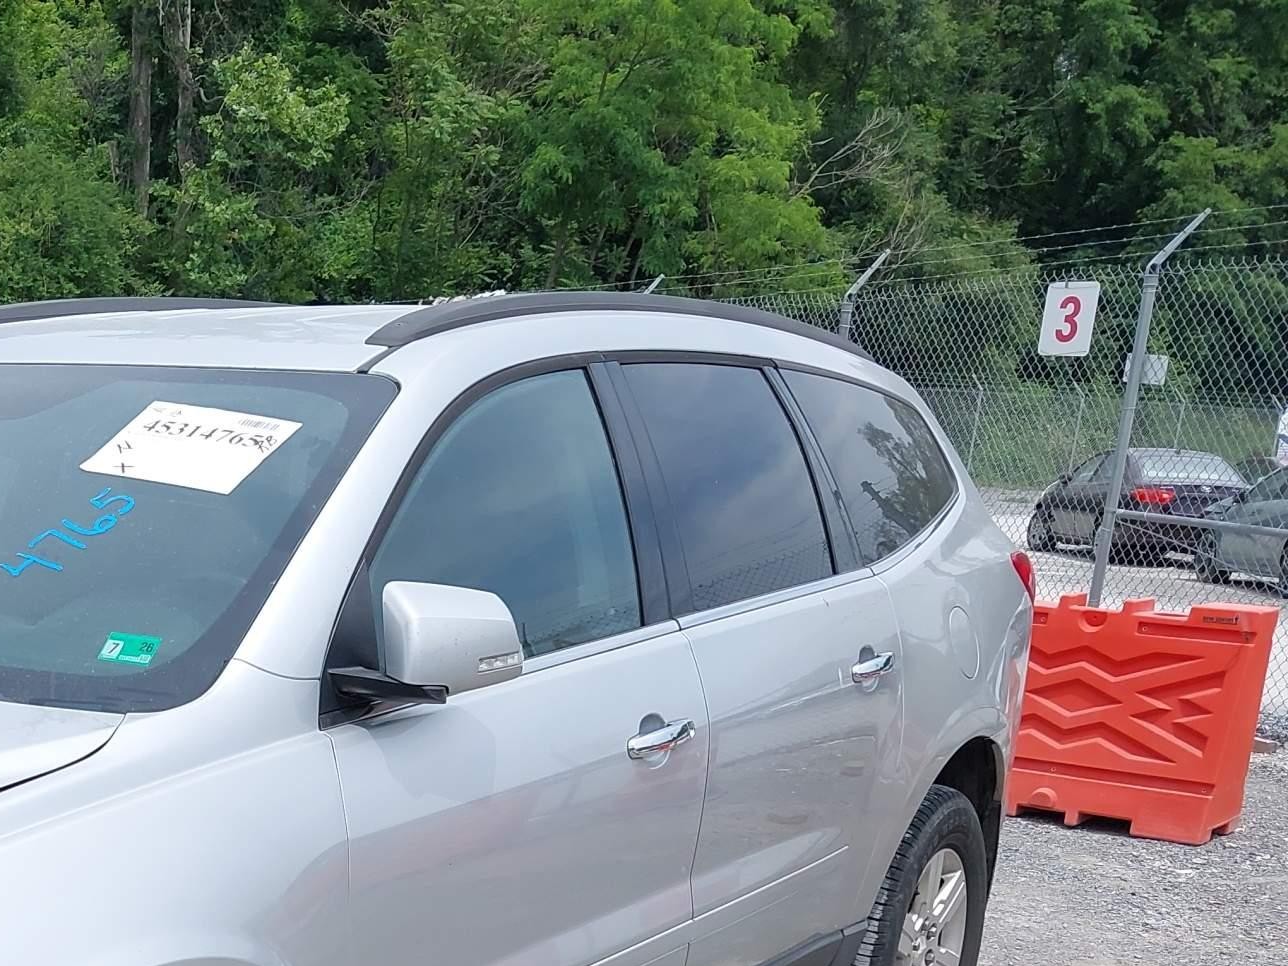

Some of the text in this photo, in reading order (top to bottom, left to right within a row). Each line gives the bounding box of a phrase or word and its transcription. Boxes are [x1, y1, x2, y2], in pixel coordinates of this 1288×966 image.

[1055, 295, 1081, 343] 3
[143, 419, 261, 448] 45314765
[107, 641, 155, 654] 7 26
